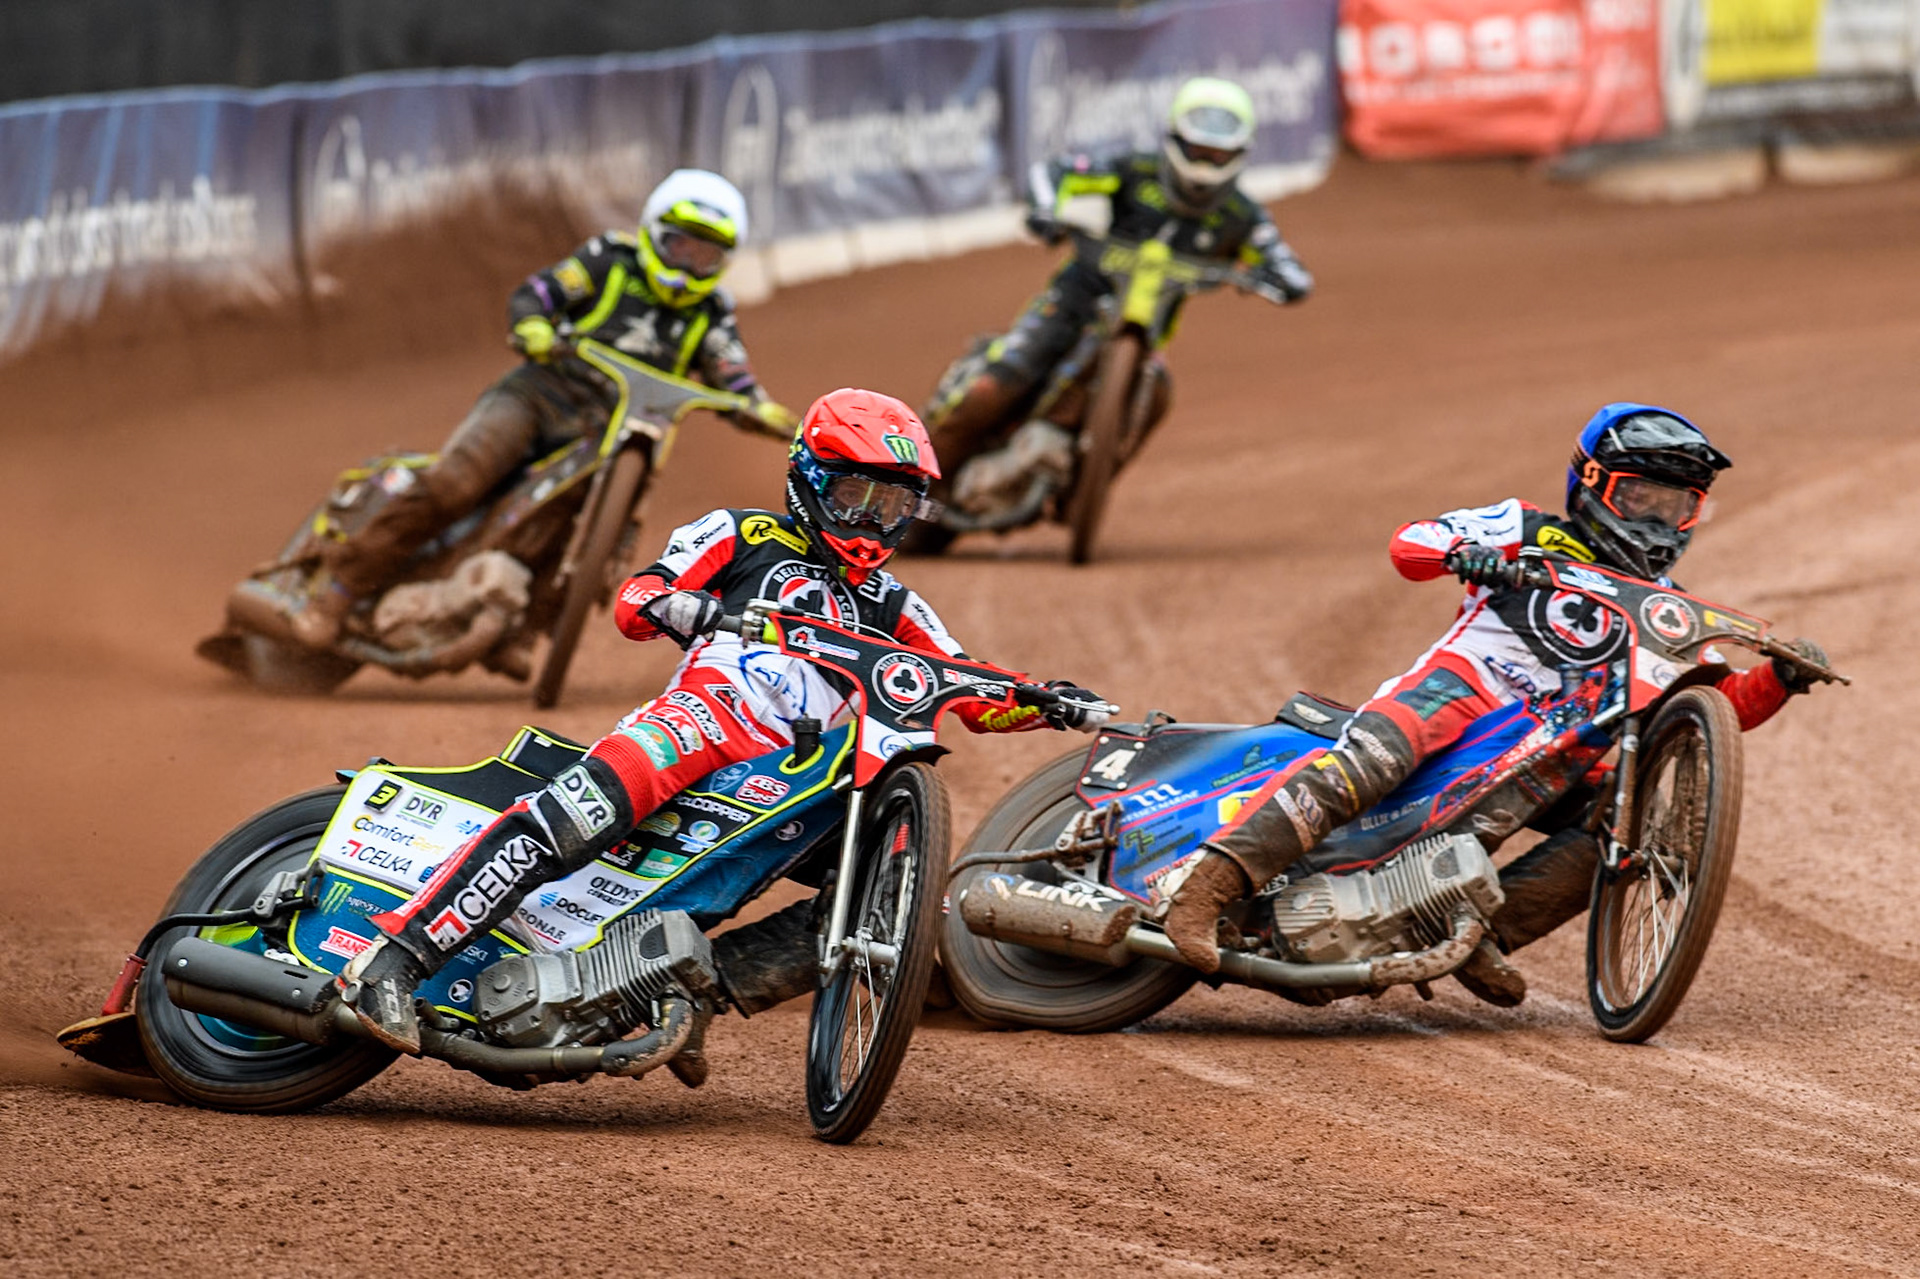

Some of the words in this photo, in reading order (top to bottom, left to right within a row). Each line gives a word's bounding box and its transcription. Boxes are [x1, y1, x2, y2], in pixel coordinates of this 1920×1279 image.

[773, 565, 808, 584] BELLE
[1091, 748, 1138, 782] 4
[368, 784, 398, 805] 3
[404, 796, 444, 820] DVR
[562, 773, 608, 828] DVR
[357, 846, 413, 875] CELKA
[457, 835, 549, 921] CELKA
[1015, 879, 1113, 913] LINK
